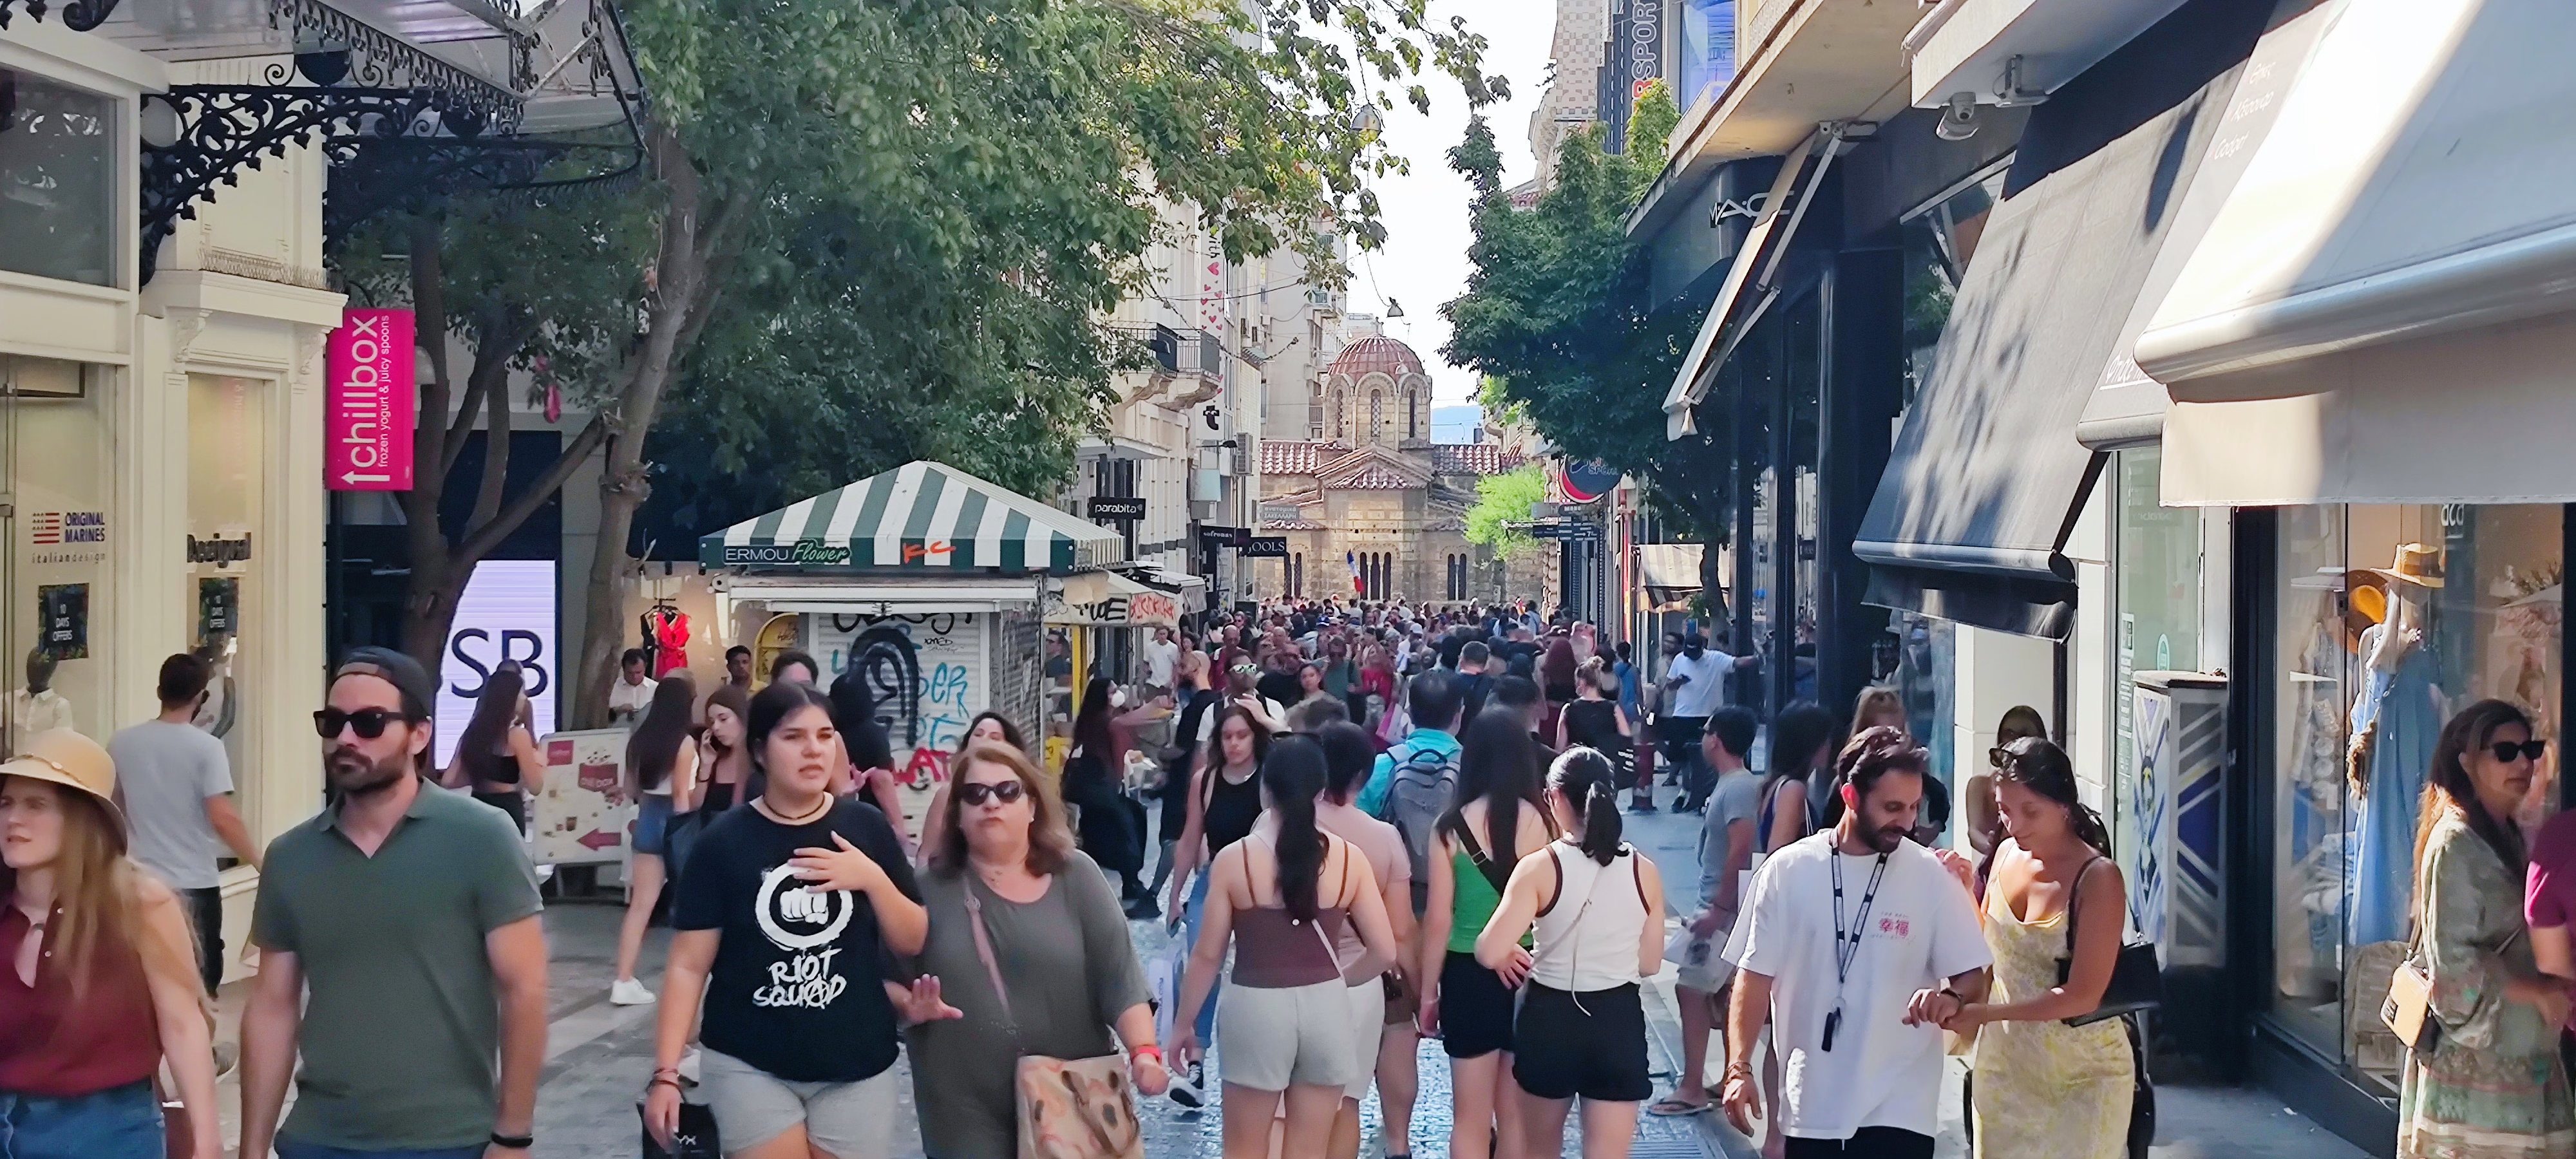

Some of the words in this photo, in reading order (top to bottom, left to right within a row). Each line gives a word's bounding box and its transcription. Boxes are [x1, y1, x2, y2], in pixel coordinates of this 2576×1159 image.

[1631, 0, 1657, 113] RSPOR
[1209, 234, 1220, 258] ith
[381, 316, 392, 355] spoons
[379, 357, 392, 382] juicy
[343, 316, 378, 468] chillbox
[379, 385, 390, 393] &
[379, 397, 391, 430] yogurt
[378, 433, 389, 467] frozen
[65, 513, 105, 526] ORIGINAL
[1095, 504, 1137, 513] parabita
[64, 528, 105, 543] MARINES
[725, 548, 789, 561] ERMOU
[791, 542, 848, 561] Flower
[766, 945, 842, 985] RIOT
[752, 973, 847, 1010] SQUAD
[673, 1135, 697, 1145] YX
